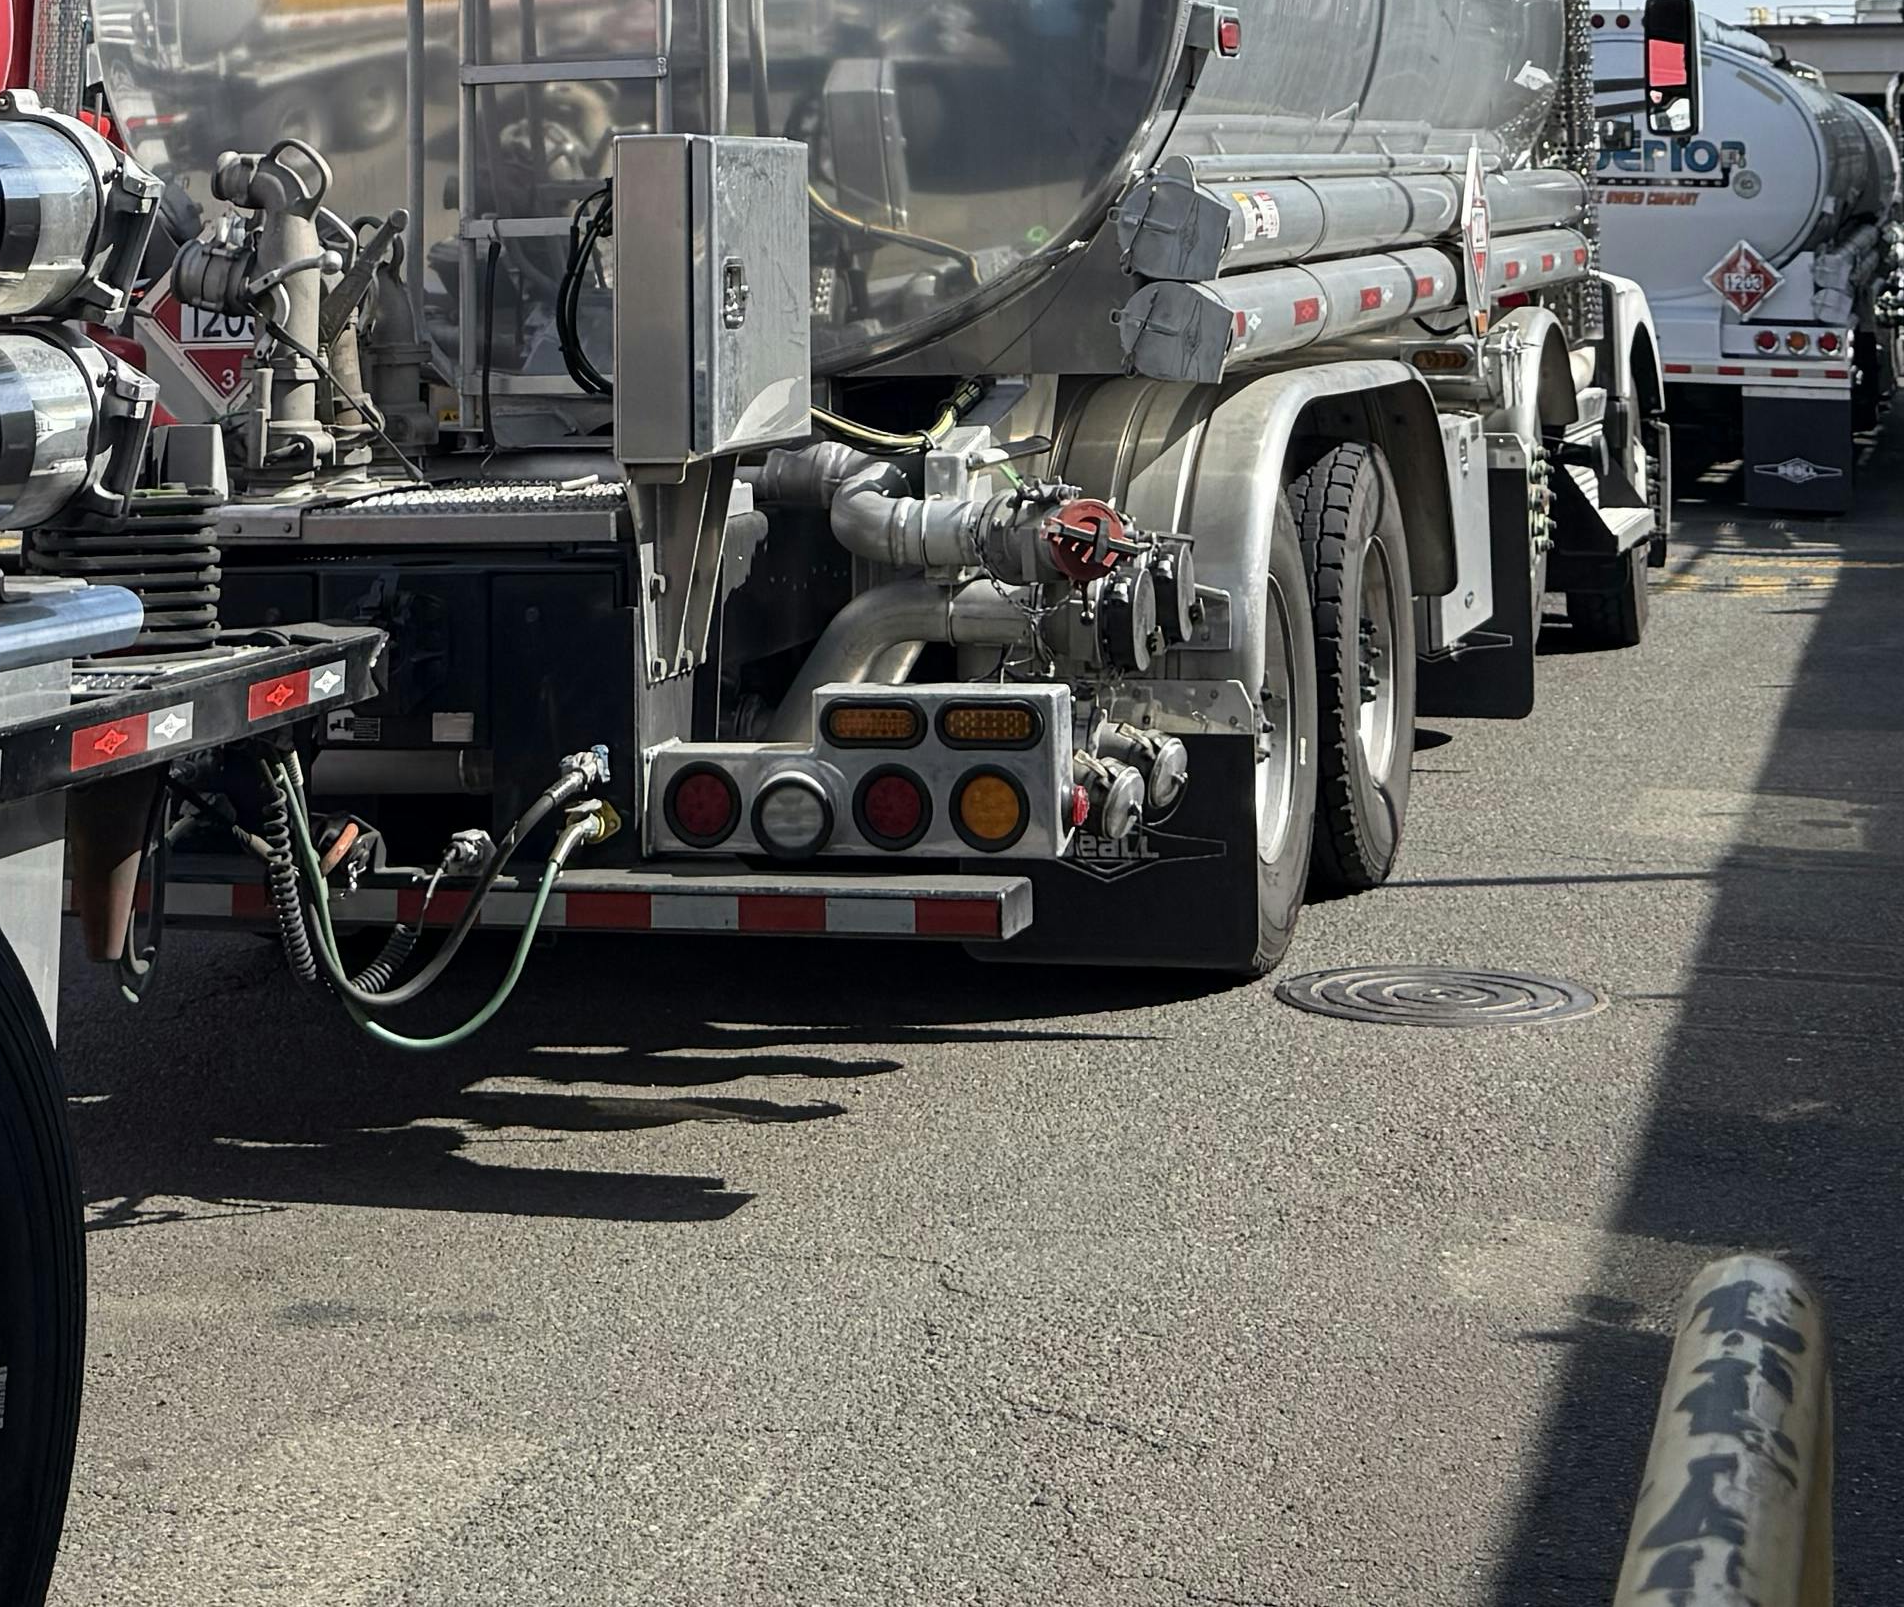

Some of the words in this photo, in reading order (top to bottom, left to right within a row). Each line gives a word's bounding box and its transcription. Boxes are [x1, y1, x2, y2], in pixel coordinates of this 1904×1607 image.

[1727, 275, 1762, 291] 1203
[194, 307, 255, 338] 120
[222, 370, 235, 389] 3
